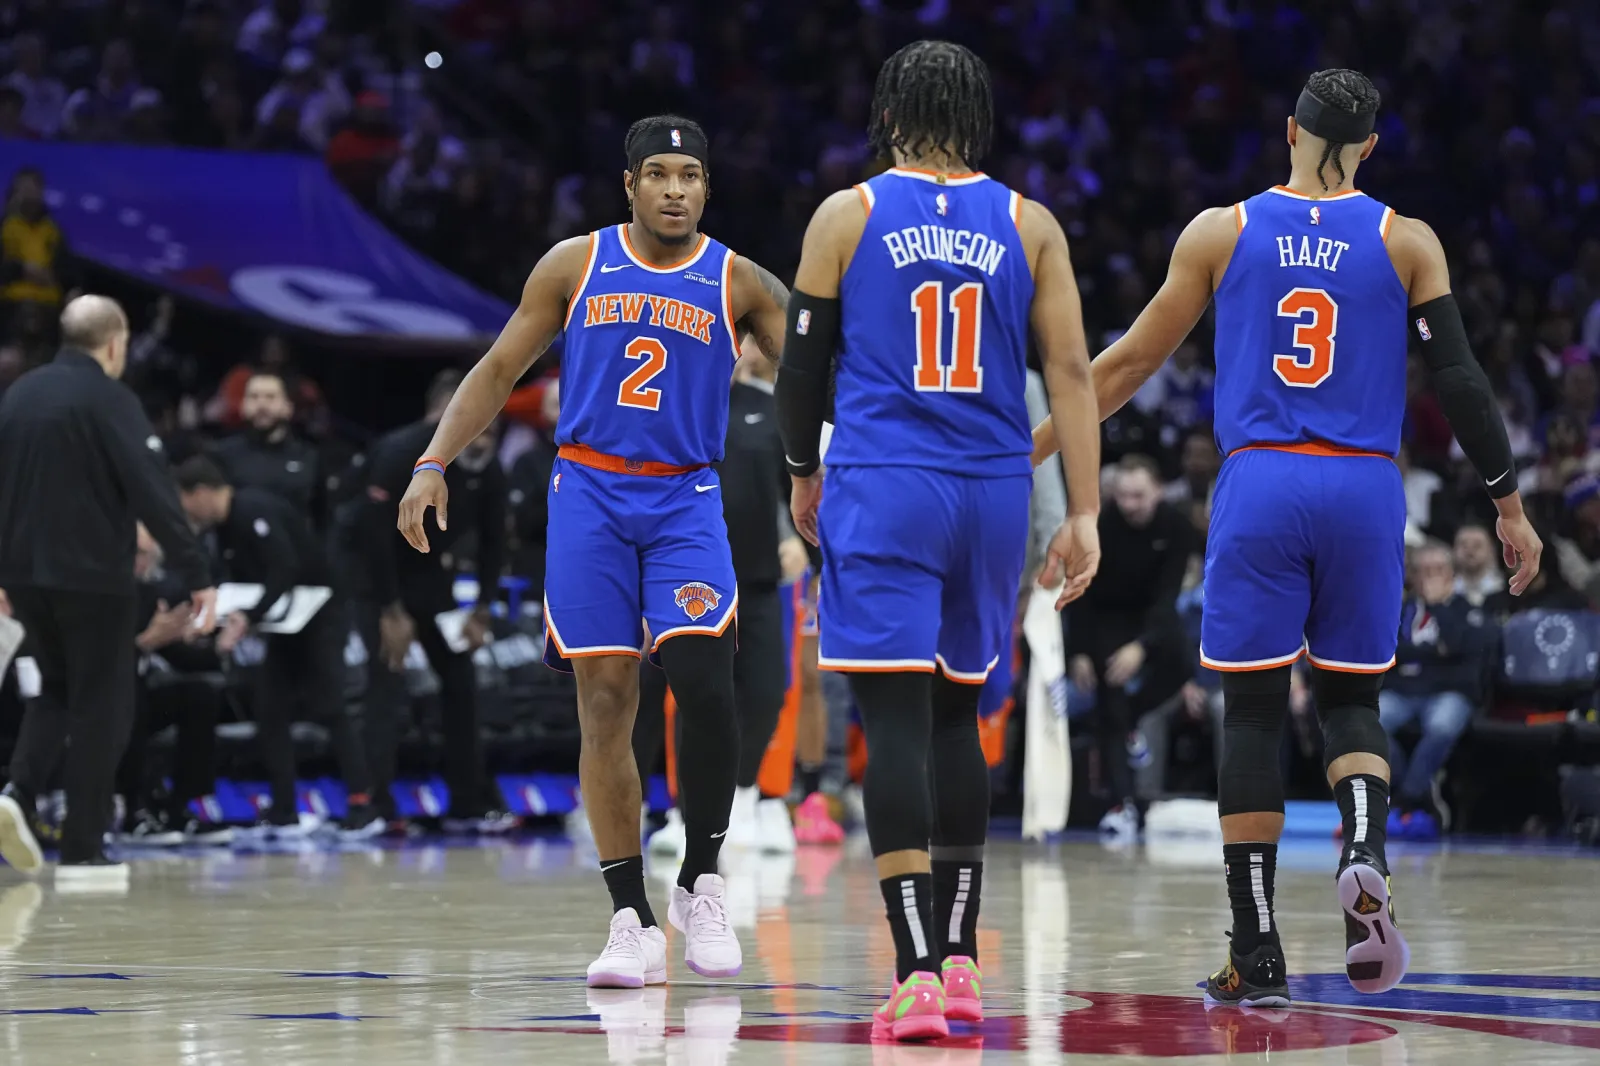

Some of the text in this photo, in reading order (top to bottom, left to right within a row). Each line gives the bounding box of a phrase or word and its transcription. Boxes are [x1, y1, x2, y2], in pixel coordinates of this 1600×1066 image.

[882, 225, 1006, 276] BRUNSON
[1276, 235, 1350, 272] HART
[584, 293, 716, 346] NEW YORK
[911, 281, 983, 393] 11
[1272, 287, 1339, 389] 3
[616, 336, 668, 412] 2
[676, 586, 717, 606] KNICKS
